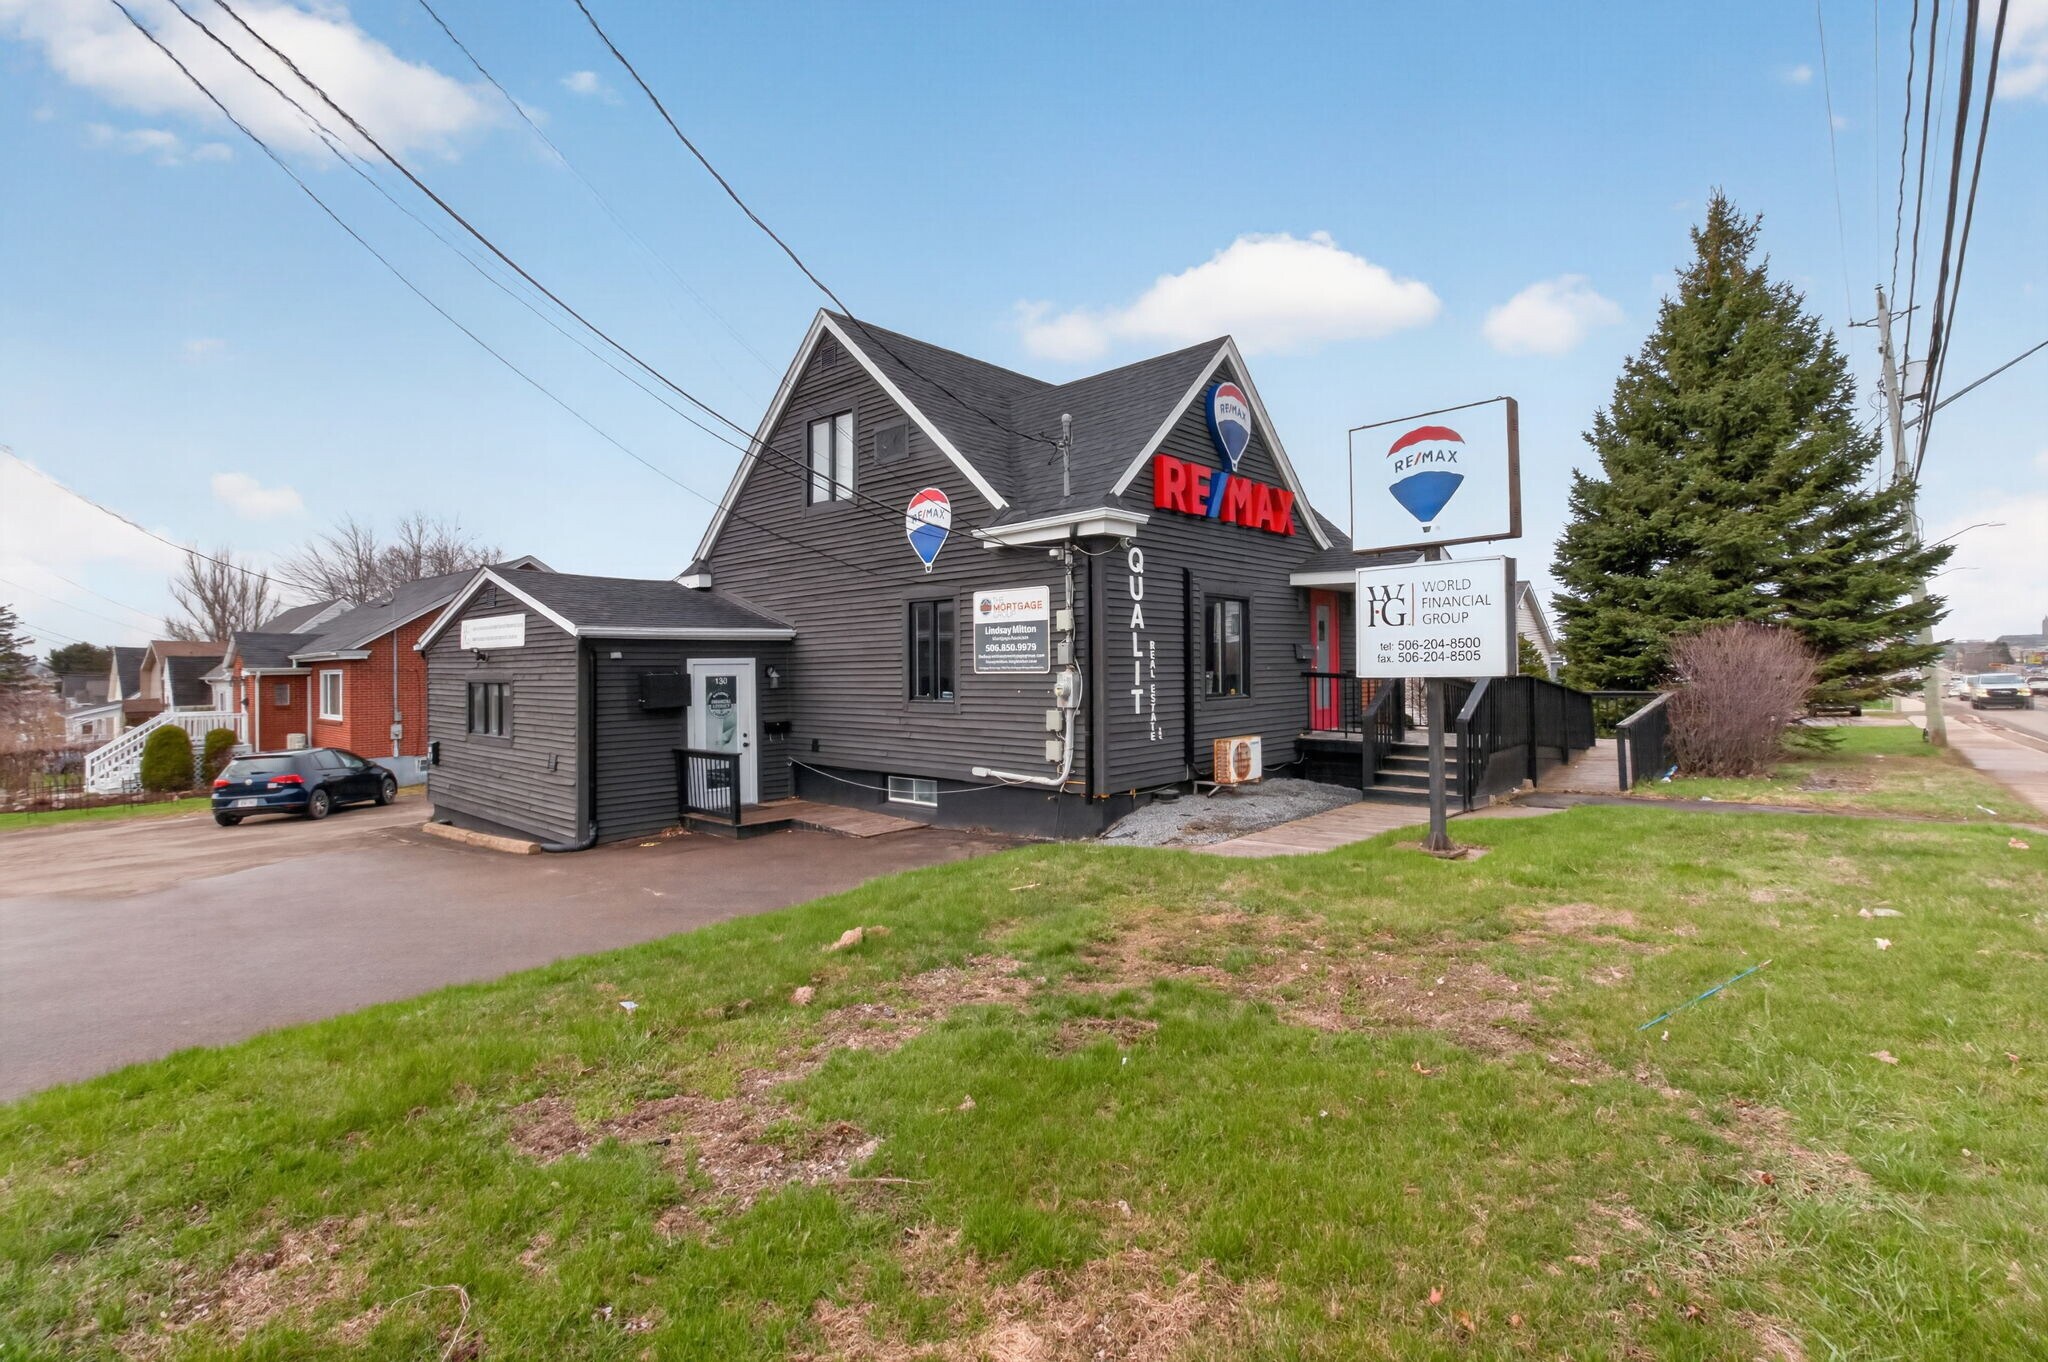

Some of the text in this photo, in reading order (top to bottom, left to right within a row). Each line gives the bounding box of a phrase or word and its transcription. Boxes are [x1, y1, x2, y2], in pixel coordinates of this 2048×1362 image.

[1219, 402, 1247, 419] RE/MAX
[1394, 449, 1458, 474] RE/MAX
[1153, 453, 1296, 536] RE/MAX
[1422, 578, 1471, 592] WORLD
[993, 600, 1043, 611] MORTGAGE
[1422, 594, 1492, 608] FINANCIAL
[1422, 611, 1469, 625] GROUP
[984, 624, 1037, 635] Lindsay Mitton
[985, 642, 1037, 652] 506.850.9979
[1397, 637, 1481, 651] 506-204-8500
[1397, 650, 1481, 663] 506-204-8505
[715, 677, 728, 685] 130
